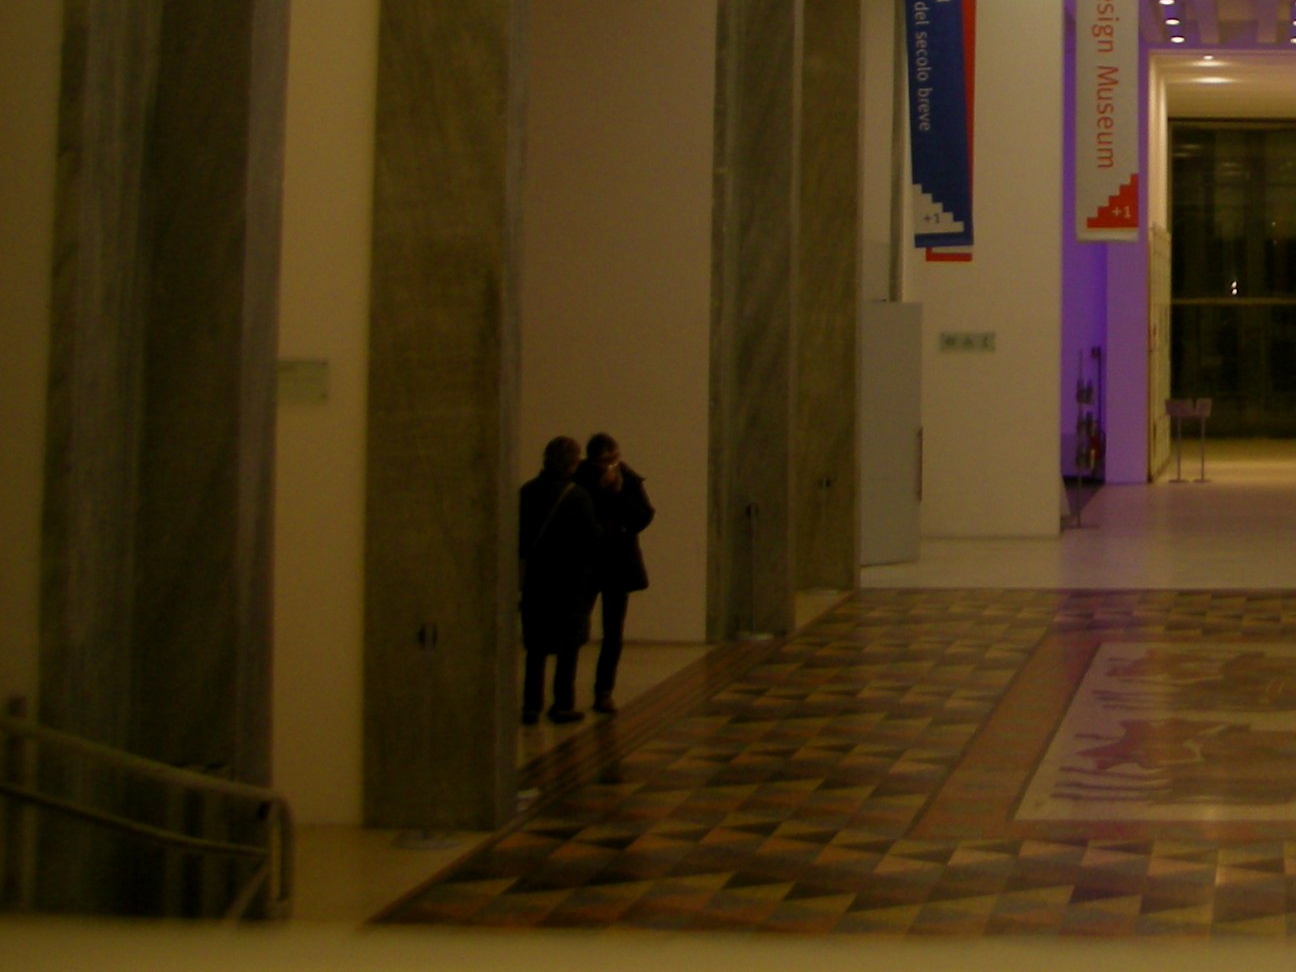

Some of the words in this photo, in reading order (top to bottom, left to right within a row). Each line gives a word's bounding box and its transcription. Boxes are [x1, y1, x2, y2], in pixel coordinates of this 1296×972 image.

[913, 1, 931, 25] del
[915, 31, 933, 83] secolo
[917, 87, 934, 132] breve
[1096, 65, 1120, 169] Museum
[1111, 205, 1132, 219] +1
